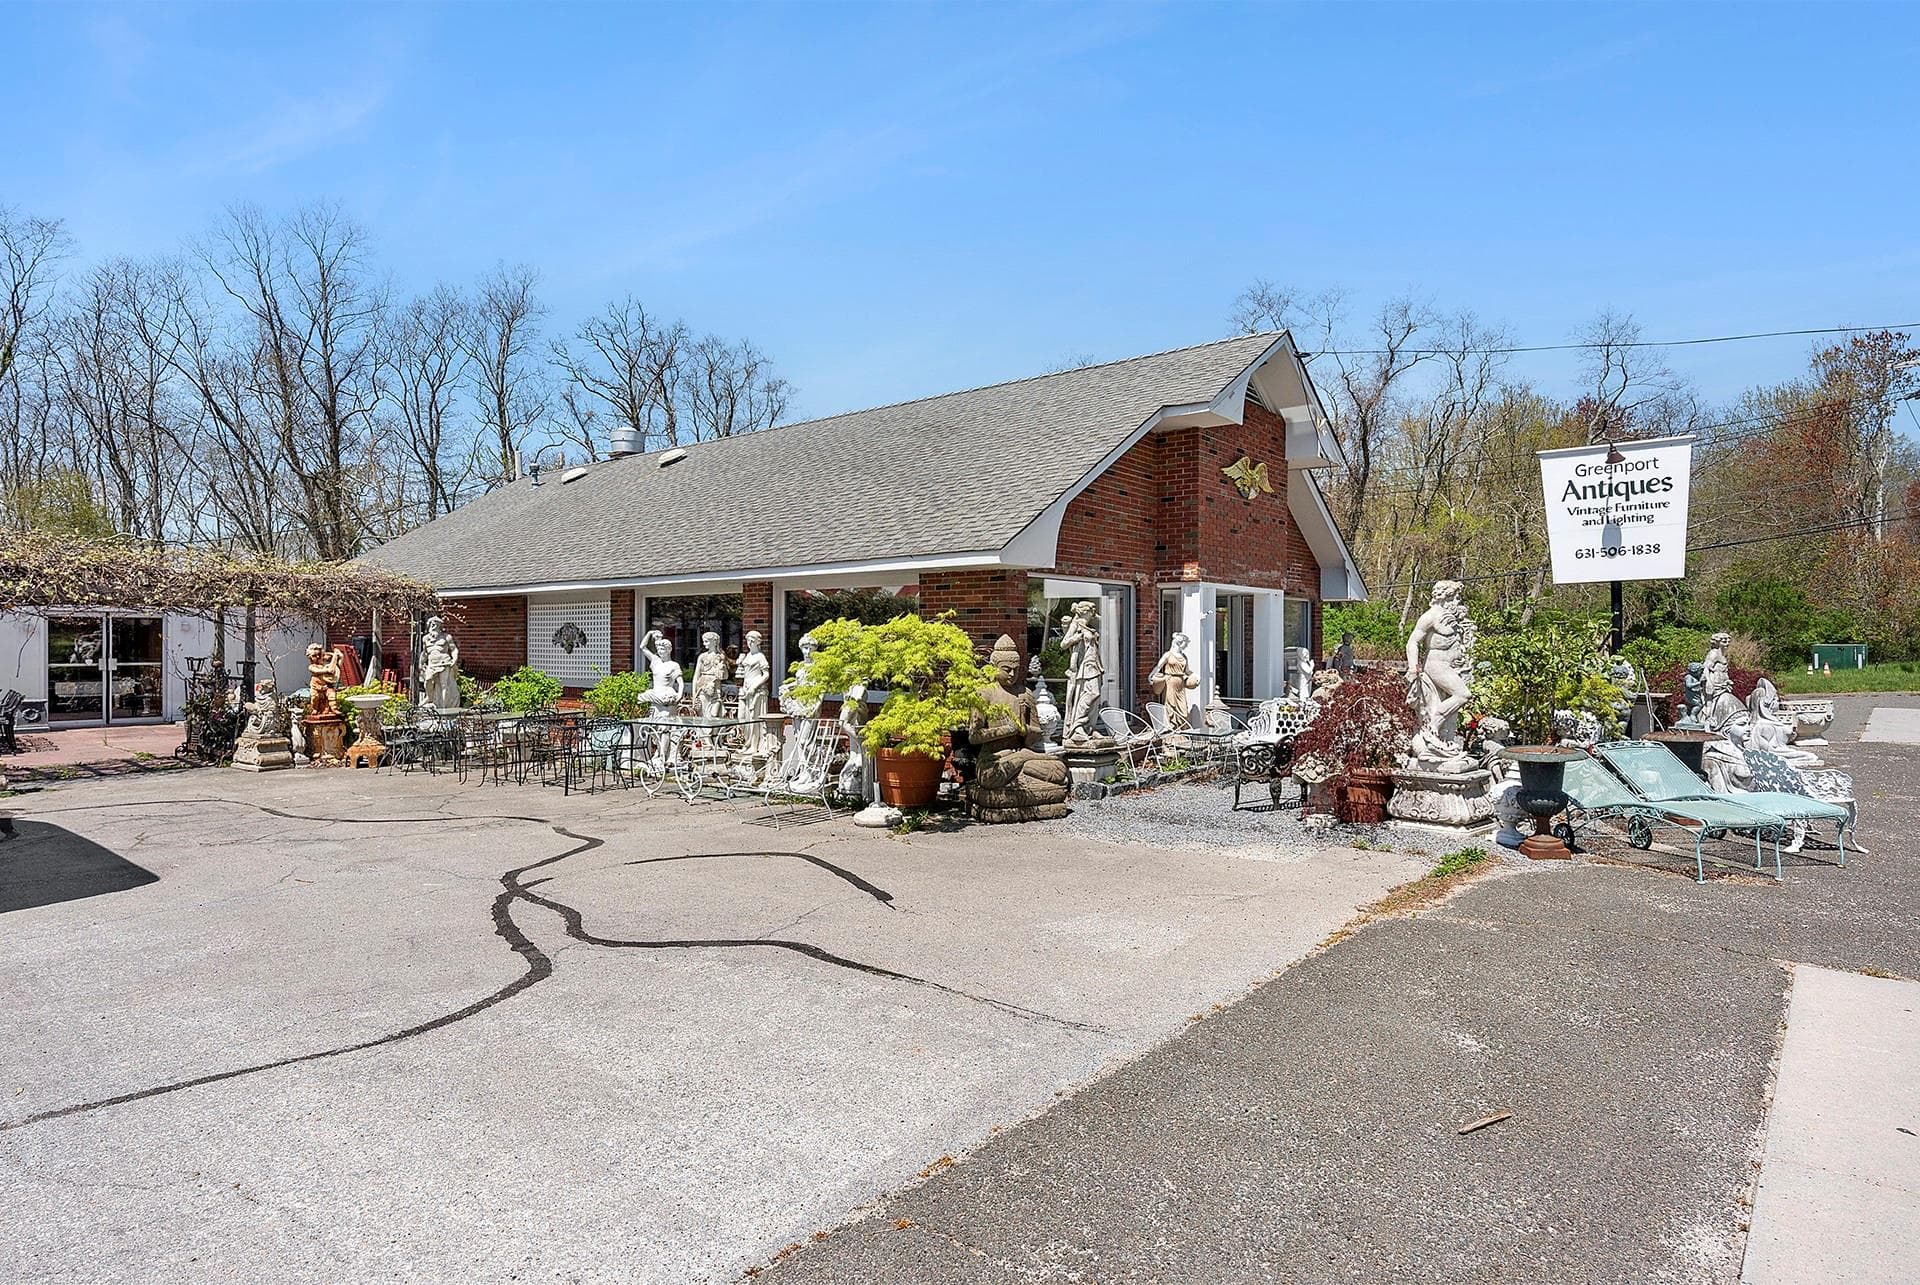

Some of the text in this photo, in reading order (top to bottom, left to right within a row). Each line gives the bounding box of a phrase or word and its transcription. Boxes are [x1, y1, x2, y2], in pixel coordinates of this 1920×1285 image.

[1575, 456, 1660, 477] Greenport
[1561, 476, 1673, 502] Antiques
[1567, 500, 1670, 516] Vintage Furniture
[1582, 513, 1654, 526] and Lighting
[1575, 543, 1661, 560] 631-506-1838
